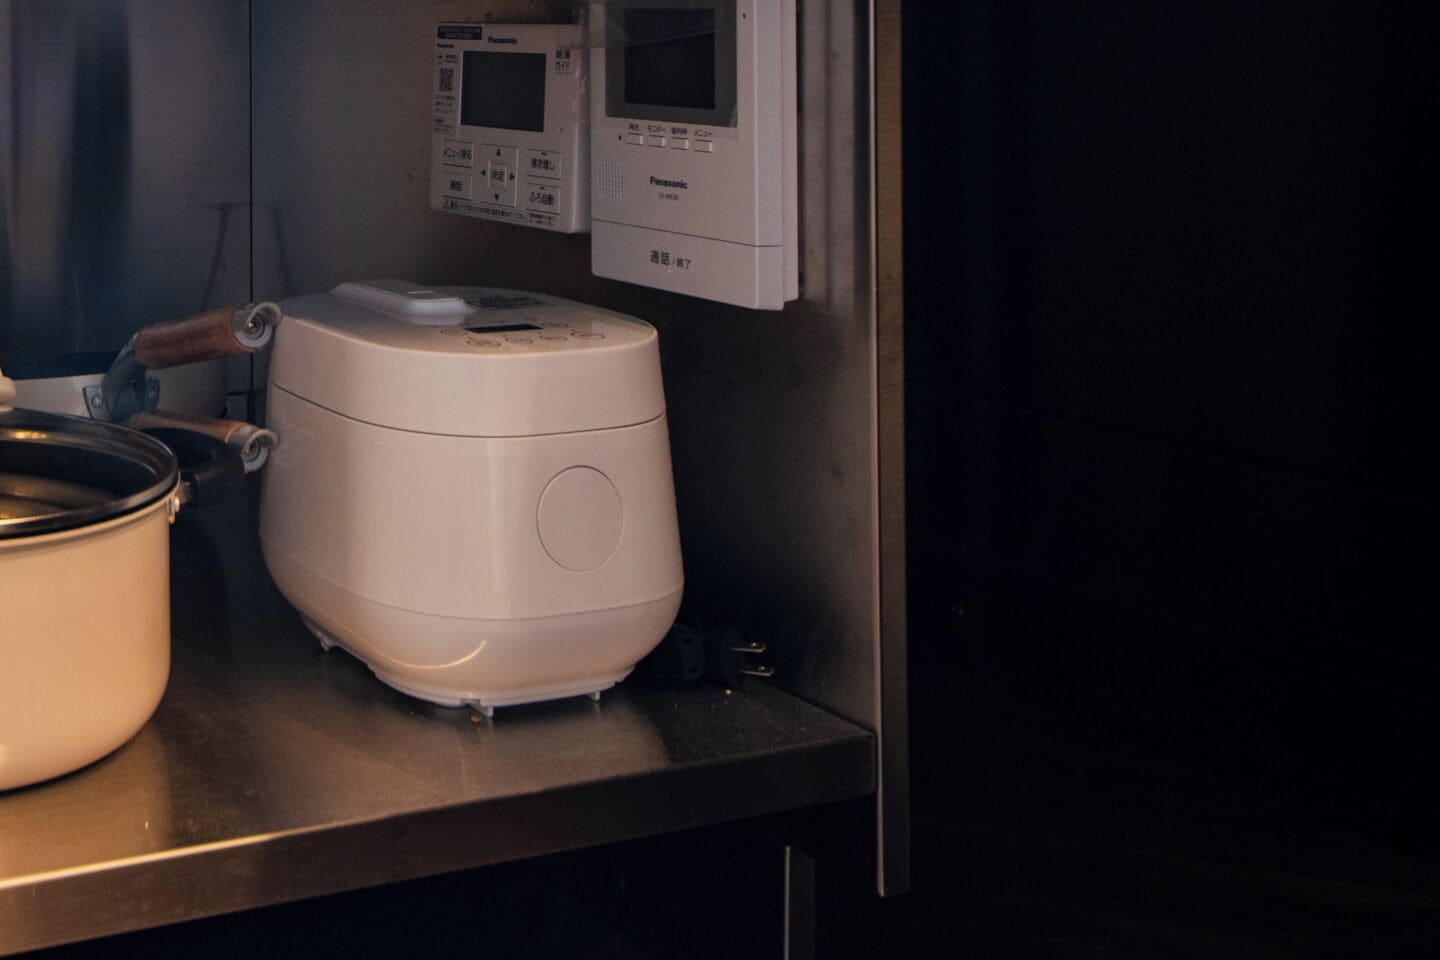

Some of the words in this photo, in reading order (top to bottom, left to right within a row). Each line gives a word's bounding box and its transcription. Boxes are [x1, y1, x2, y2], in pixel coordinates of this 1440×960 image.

[650, 176, 688, 189] Panasonic
[529, 192, 554, 206] ふろ自動
